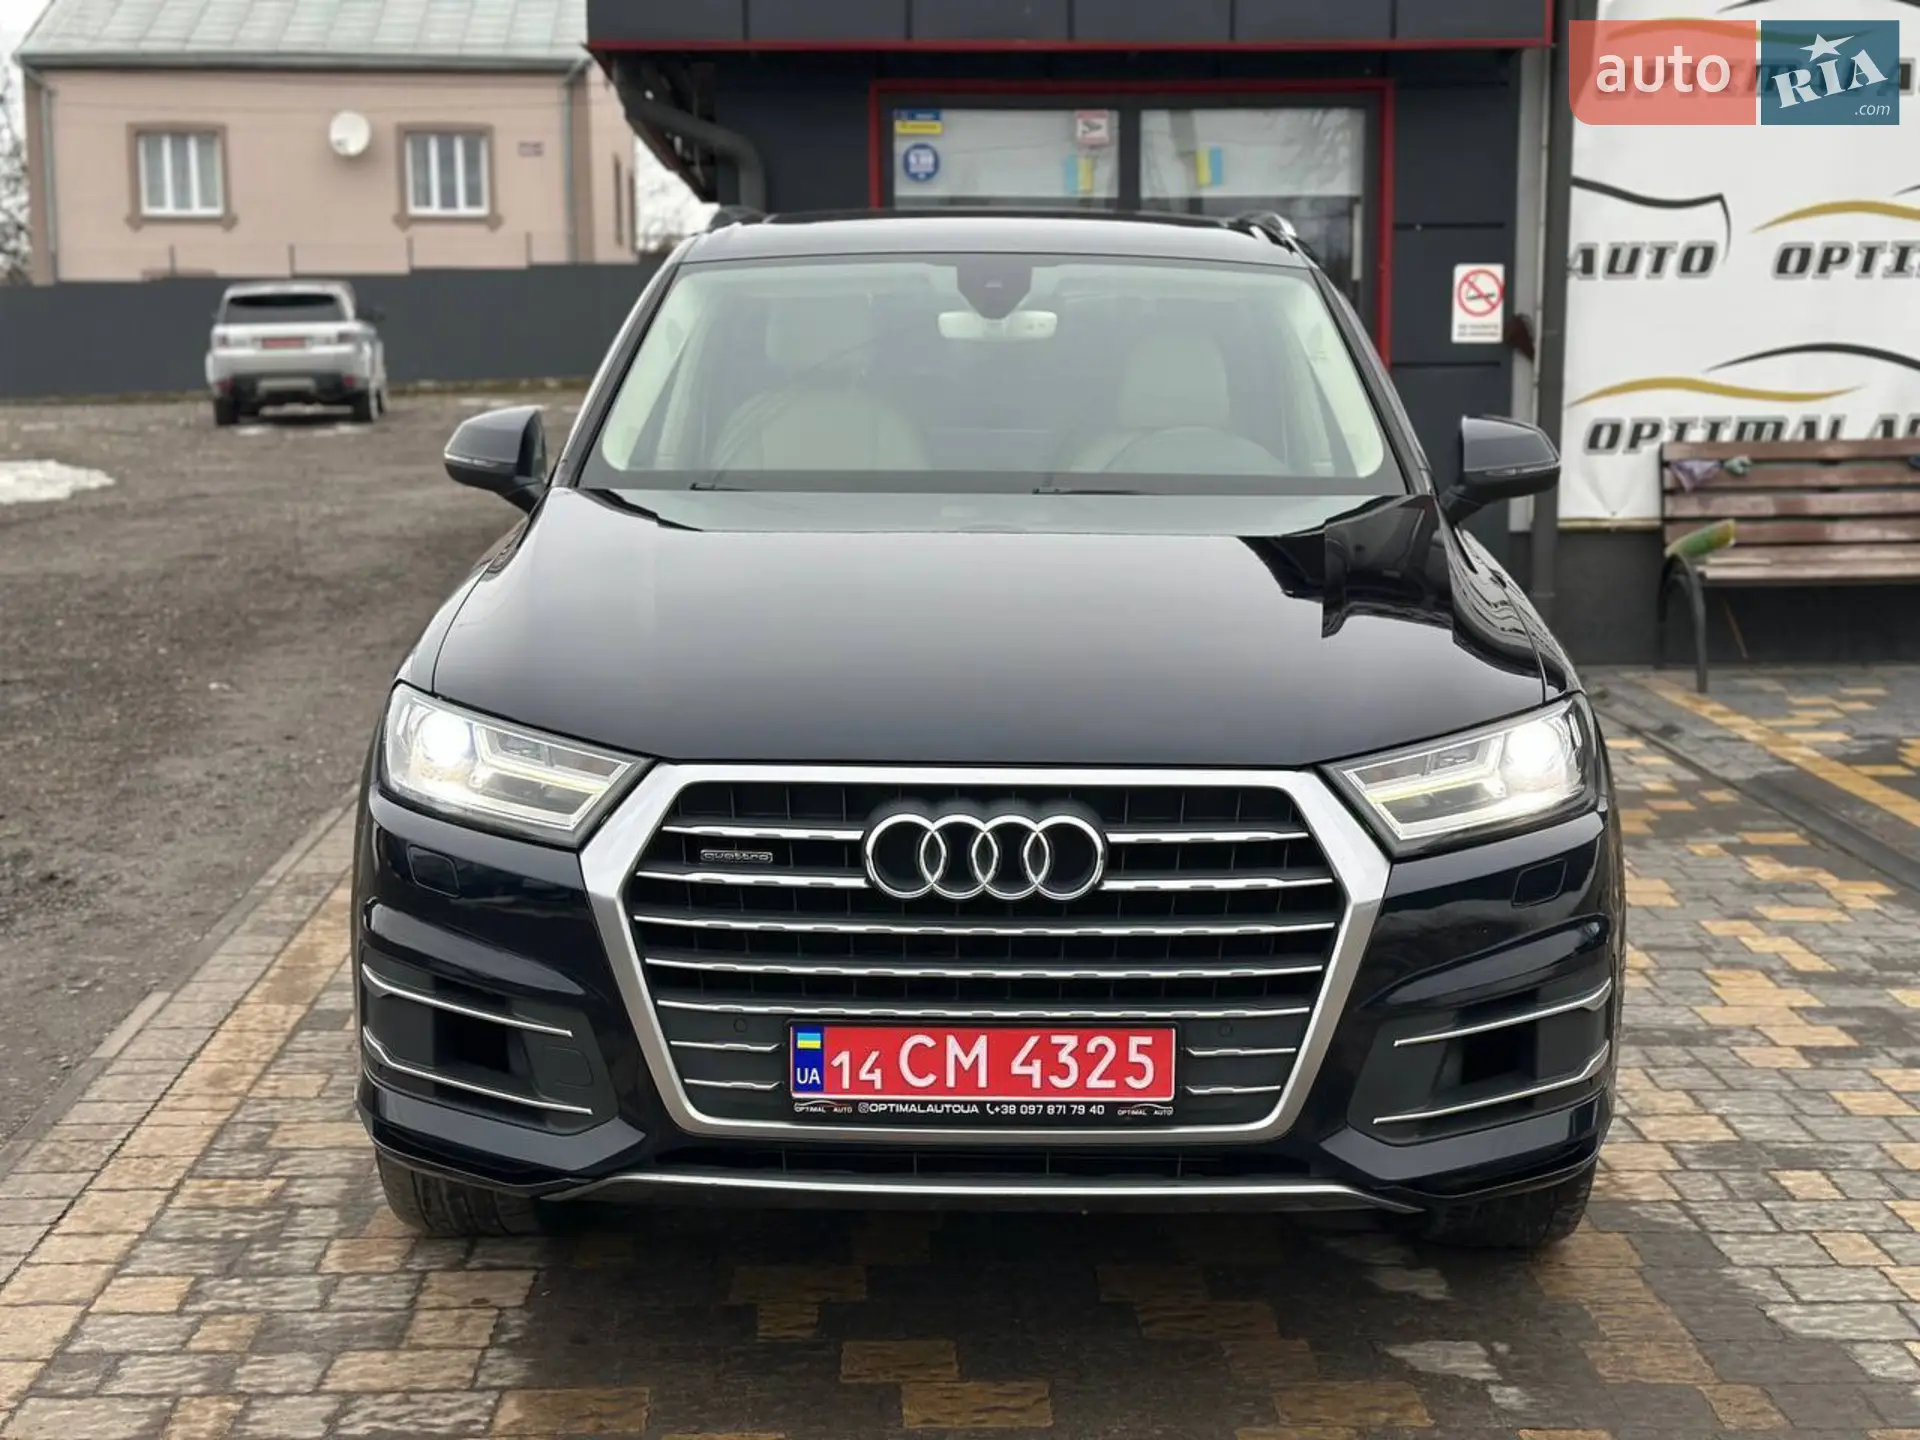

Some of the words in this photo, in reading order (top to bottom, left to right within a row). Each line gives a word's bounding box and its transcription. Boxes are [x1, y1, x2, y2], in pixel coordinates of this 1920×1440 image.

[1566, 241, 1719, 280] AUTO
[1771, 240, 1920, 280] OPTI
[1864, 411, 1920, 440] A
[702, 851, 770, 862] quattro
[831, 1050, 882, 1090] 14
[899, 1034, 988, 1088] CM
[1010, 1035, 1155, 1089] 4325
[796, 1067, 821, 1085] UA
[868, 1103, 980, 1114] OPTIMALAUTOUA
[994, 1104, 1017, 1115] +38
[1020, 1104, 1044, 1115] 097
[1047, 1104, 1067, 1115] 871
[1070, 1104, 1086, 1115] 79
[1089, 1104, 1105, 1115] 40
